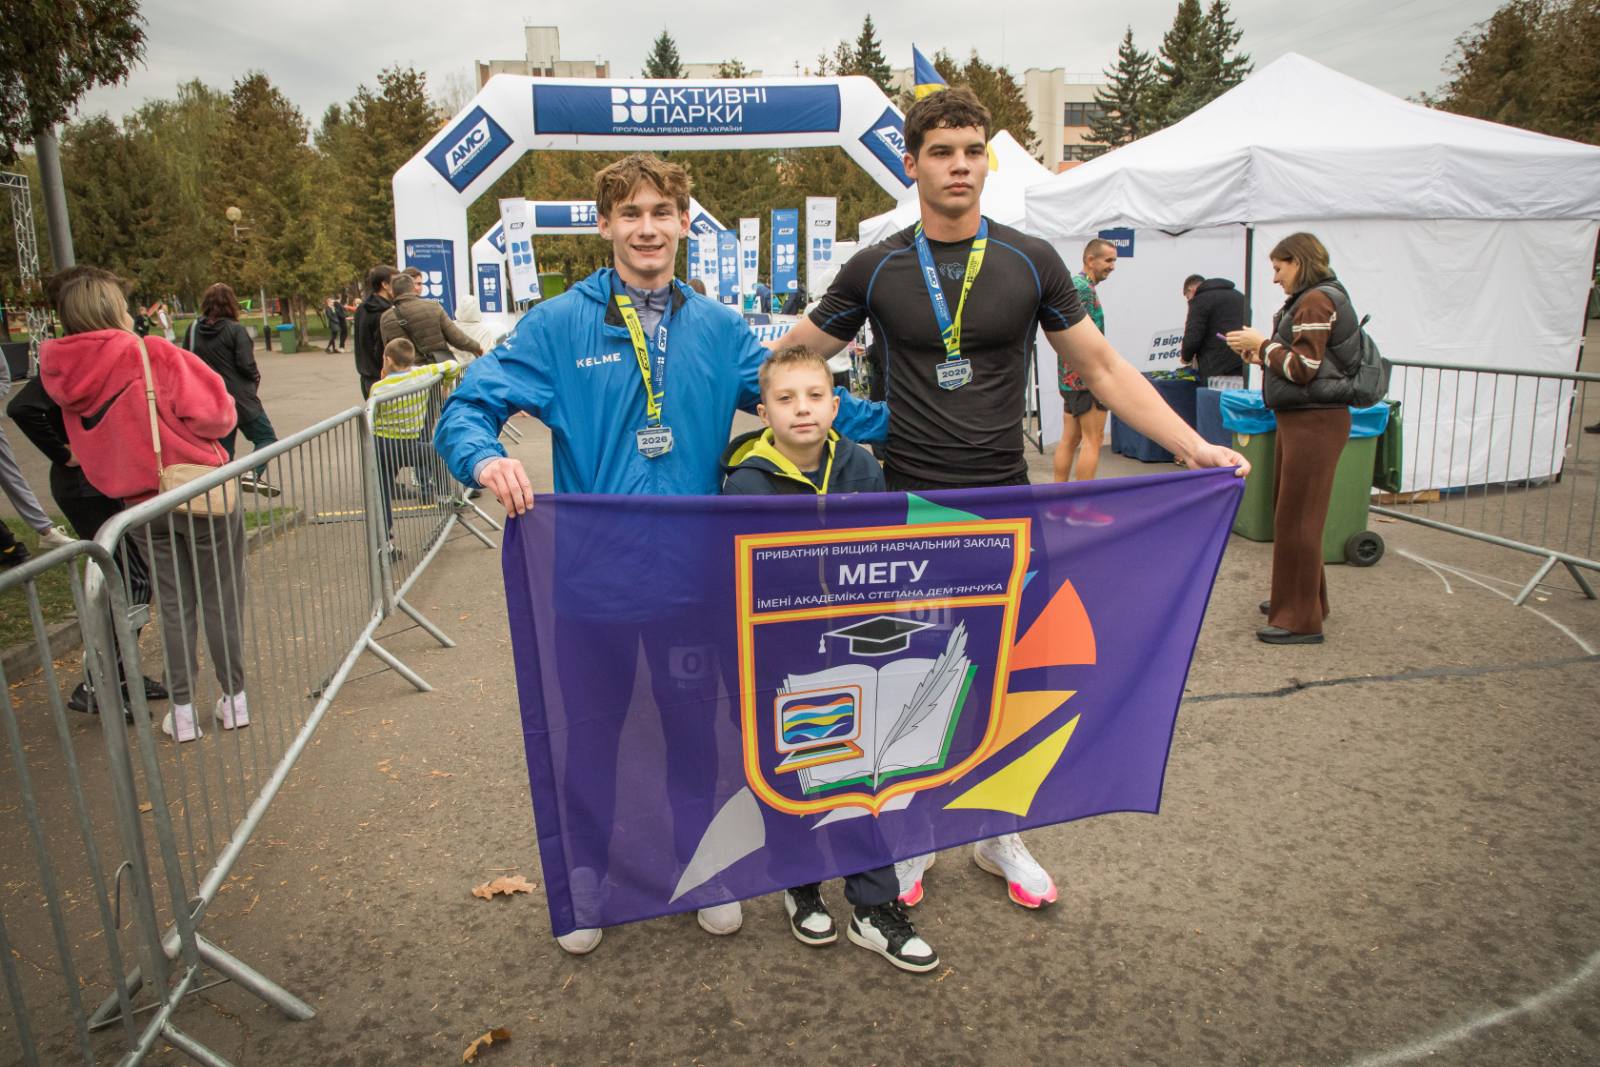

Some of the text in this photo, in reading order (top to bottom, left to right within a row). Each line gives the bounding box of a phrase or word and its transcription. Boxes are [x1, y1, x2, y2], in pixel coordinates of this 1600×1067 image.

[651, 88, 767, 105] АКТИВНІ
[651, 104, 743, 124] ПАРКИ
[709, 124, 743, 133] УКРАЇНИ
[1152, 336, 1161, 347] Я
[576, 353, 622, 369] KELME
[756, 537, 1010, 560] ПРИВАТНИЙ ВИЩИЙ НАВЧАЛЬНИЙ ЗАКЛАД
[838, 560, 929, 586] МЕГУ
[868, 588, 924, 600] СТЕПАНА
